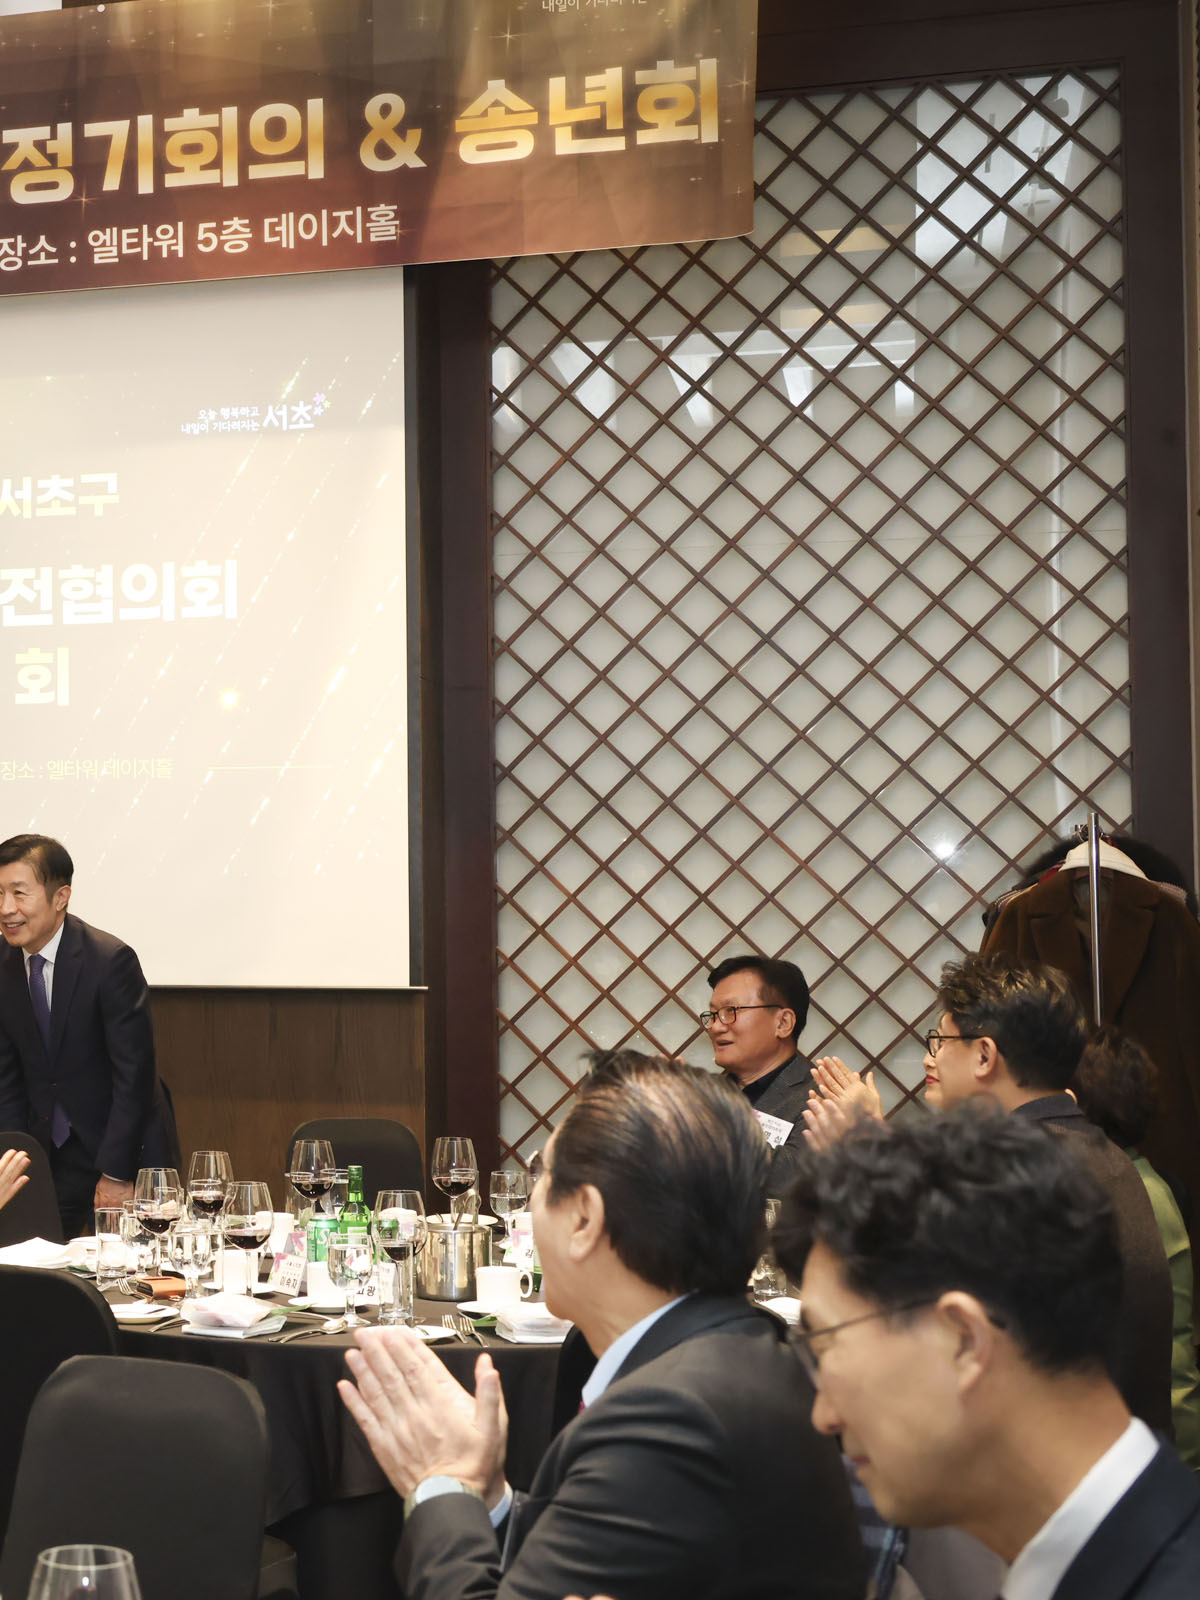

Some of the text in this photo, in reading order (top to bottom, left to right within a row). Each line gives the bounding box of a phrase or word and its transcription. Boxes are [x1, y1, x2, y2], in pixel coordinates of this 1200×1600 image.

[1, 98, 325, 205] 정기회의
[359, 92, 428, 172] &
[455, 58, 720, 166] 송년회
[87, 220, 186, 265] 엘타워
[197, 218, 255, 255] 5층
[263, 203, 399, 249] 데이지홀
[263, 400, 315, 431] 서초
[0, 761, 34, 780] 장소
